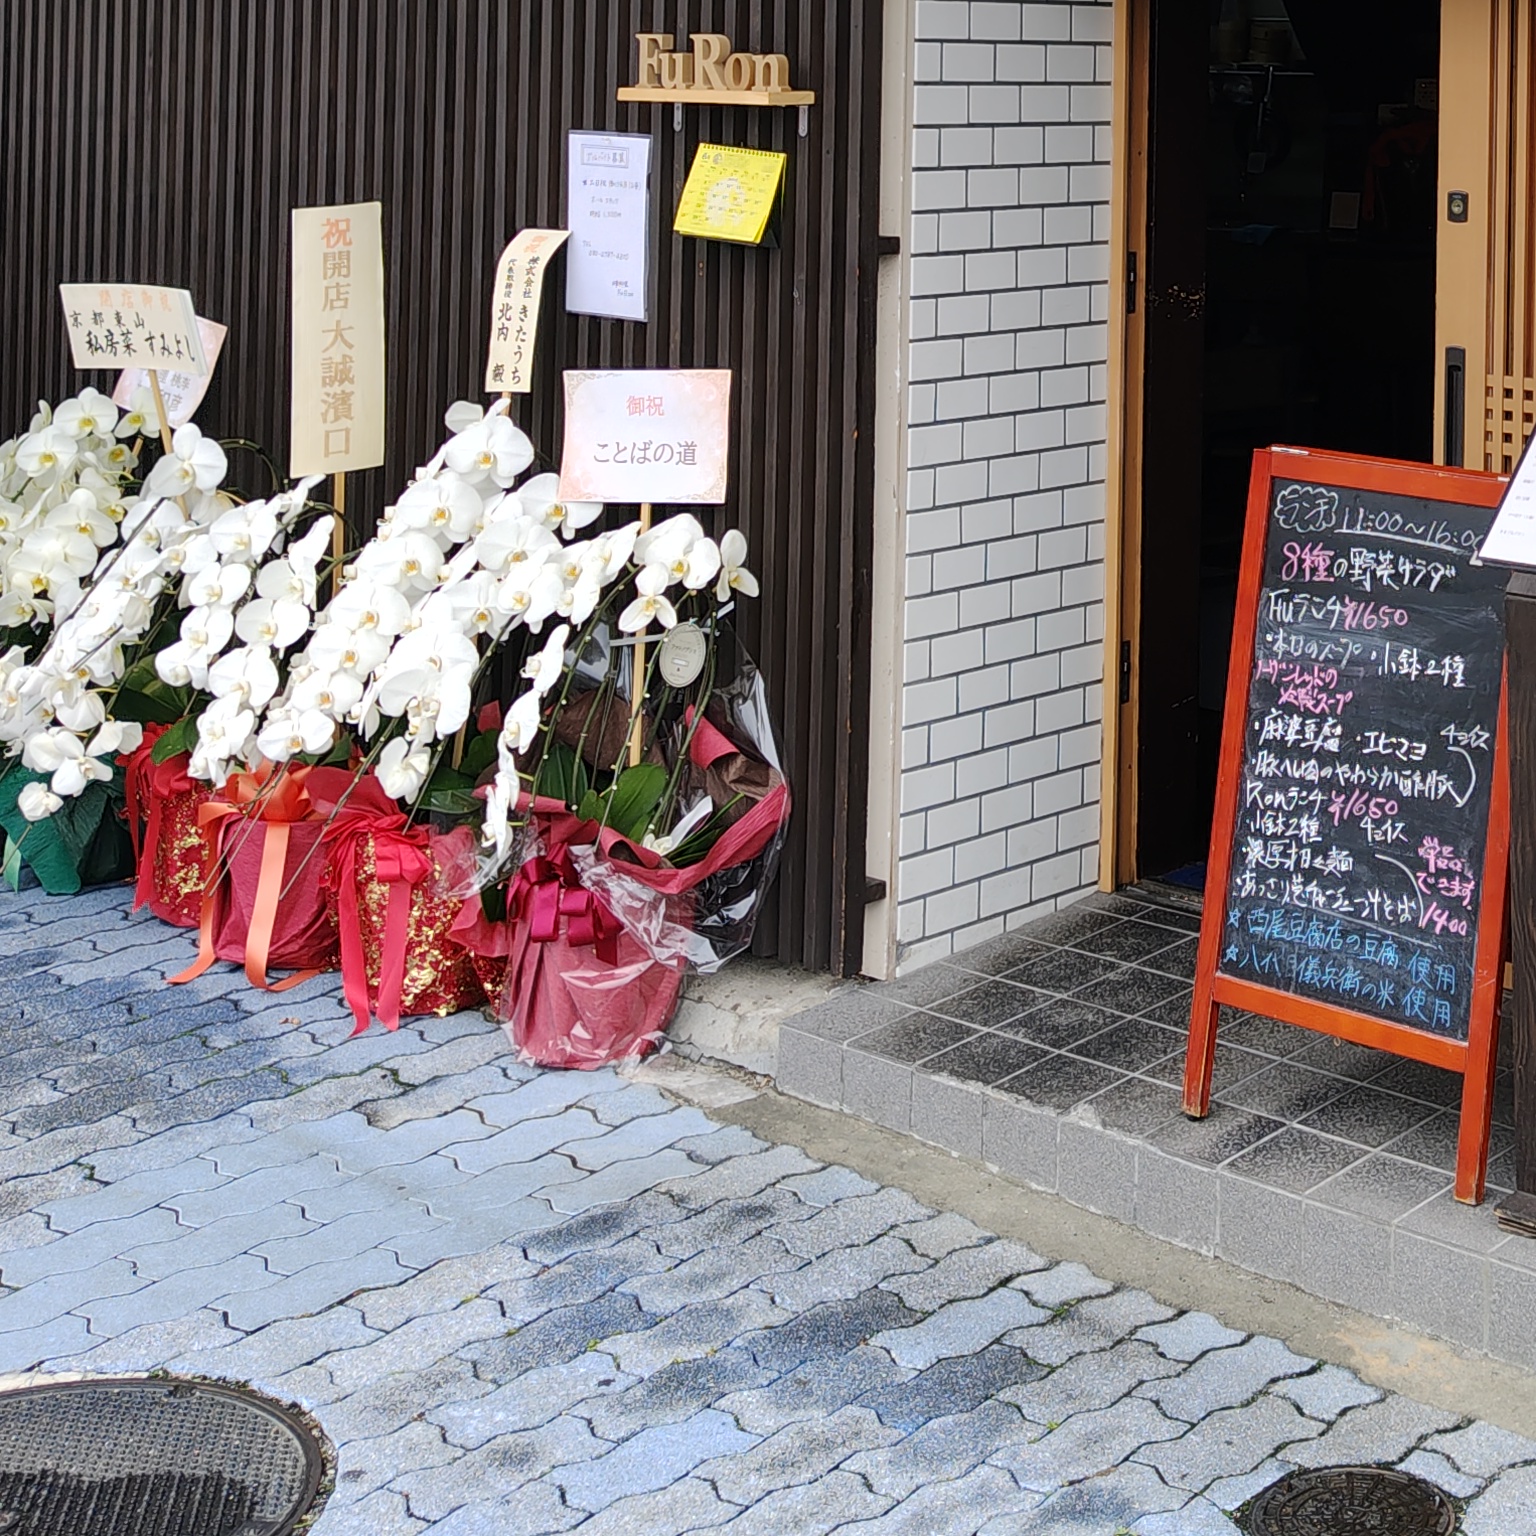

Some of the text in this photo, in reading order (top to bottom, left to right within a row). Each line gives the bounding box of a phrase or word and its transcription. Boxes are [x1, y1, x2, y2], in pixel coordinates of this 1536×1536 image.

[635, 33, 791, 92] FuRon
[626, 395, 665, 416] 御祝
[593, 439, 698, 466] ことばの道
[1284, 494, 1331, 527] ランチ
